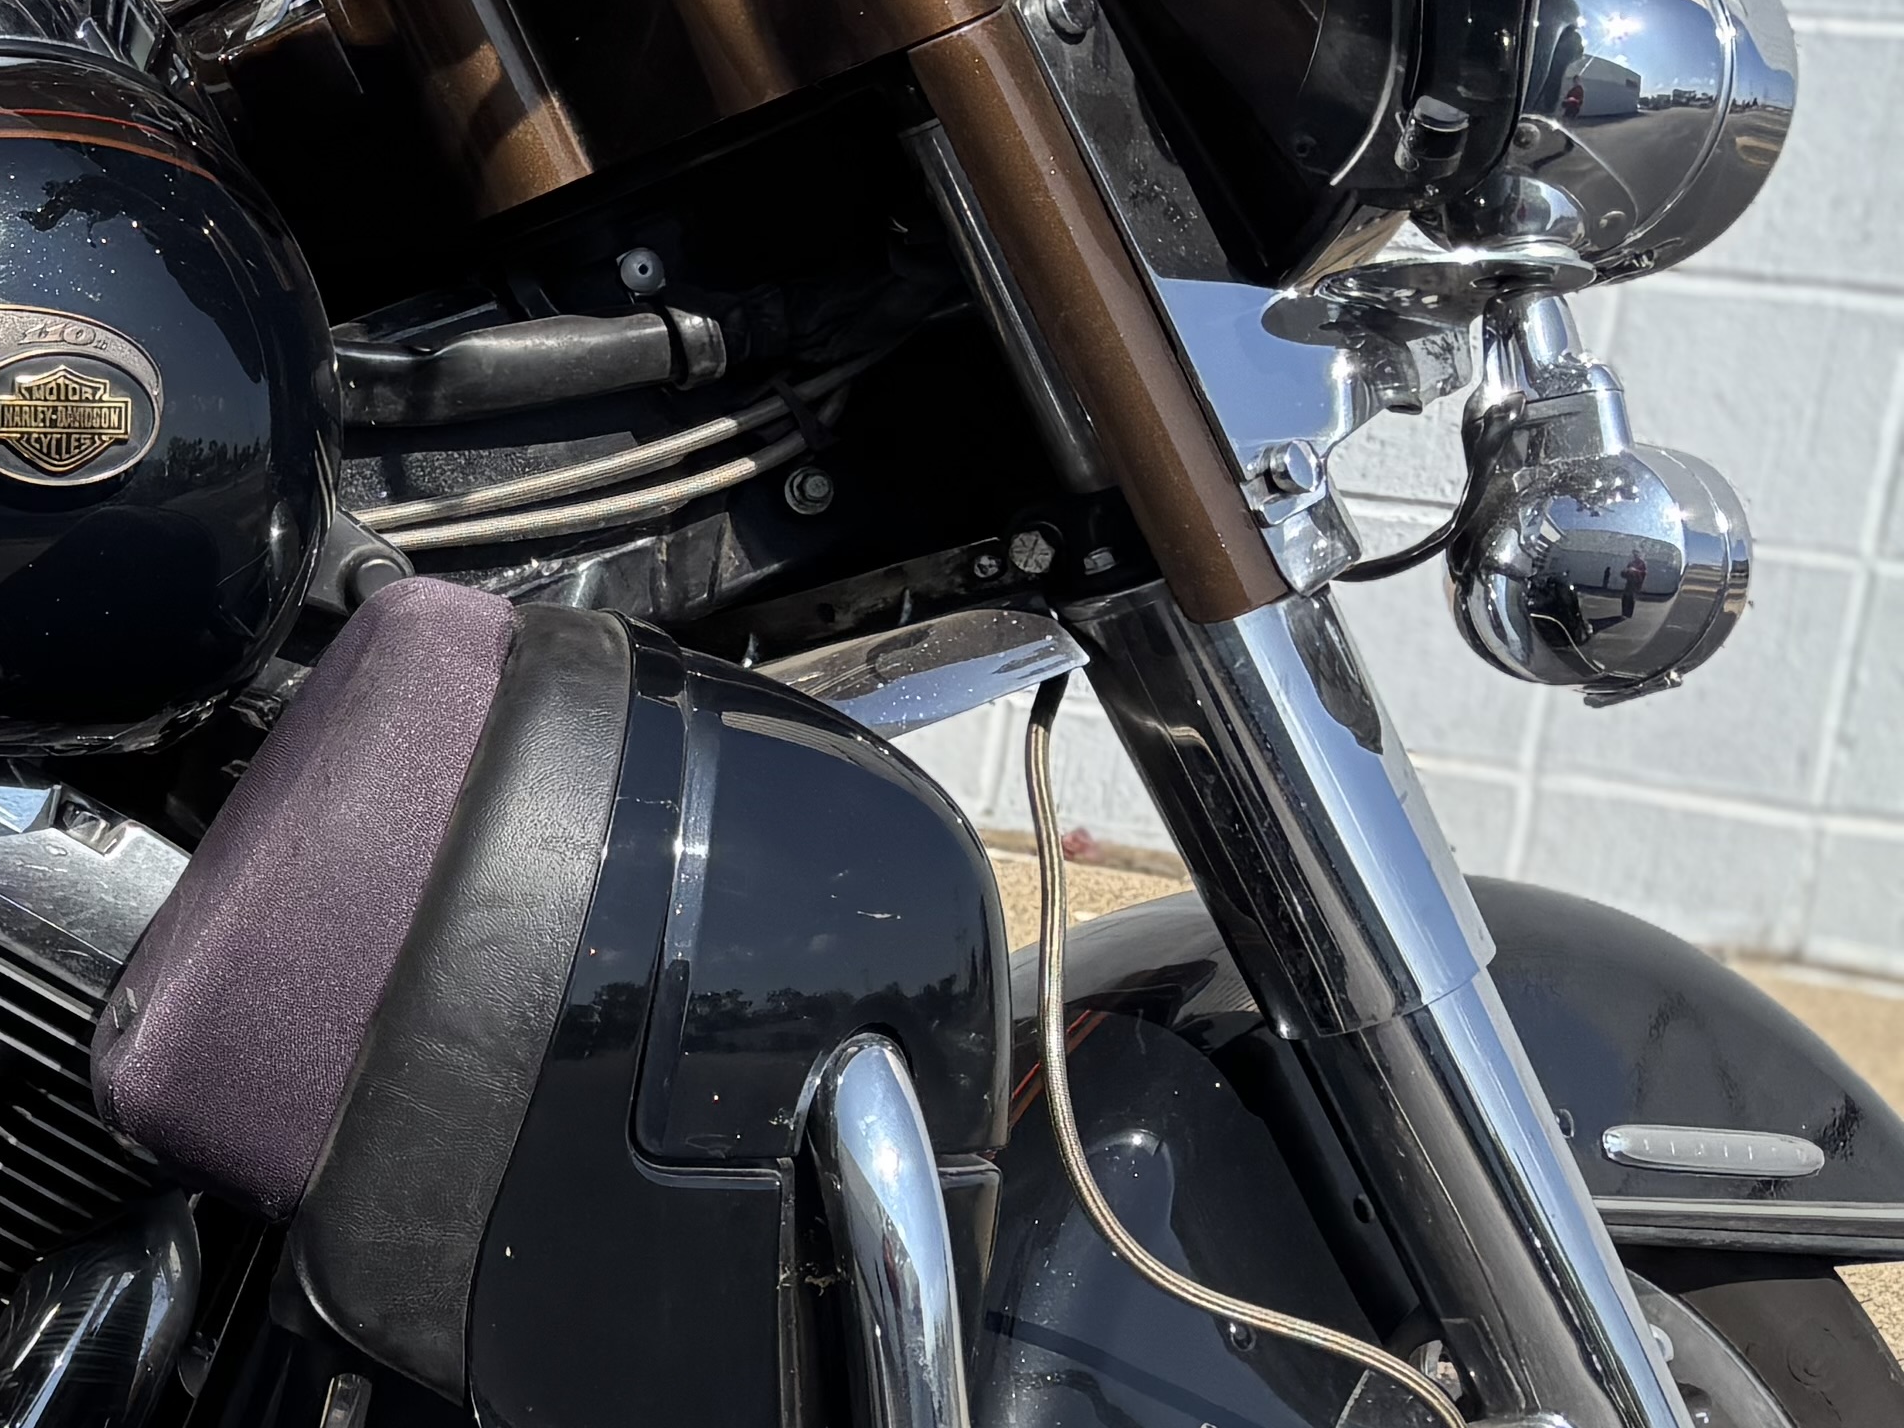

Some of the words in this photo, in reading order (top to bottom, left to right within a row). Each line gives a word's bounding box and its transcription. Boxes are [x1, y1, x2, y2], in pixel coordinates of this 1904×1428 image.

[31, 377, 94, 401] MOTOR
[3, 404, 119, 428] HARLEY-DAVIDSON
[30, 434, 92, 460] CYCLES
